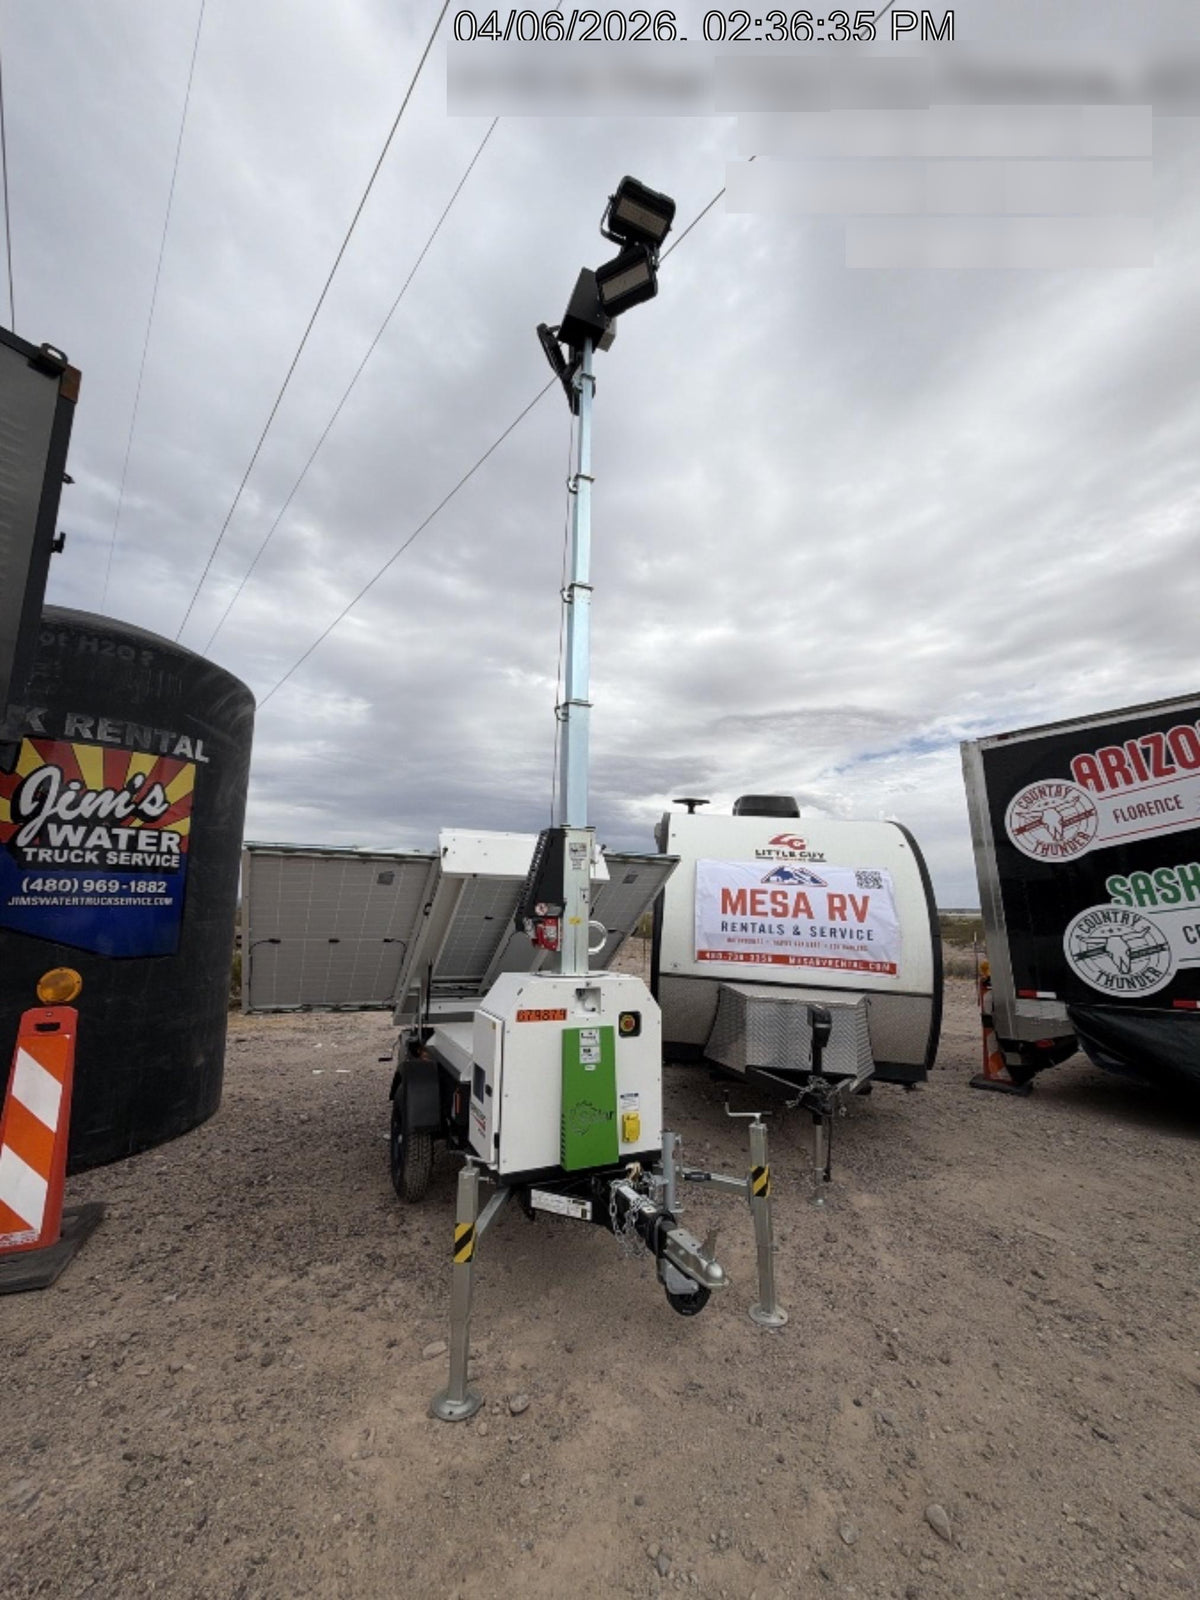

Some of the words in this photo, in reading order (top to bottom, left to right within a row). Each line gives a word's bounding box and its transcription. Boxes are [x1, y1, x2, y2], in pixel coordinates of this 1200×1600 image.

[64, 711, 211, 764] RENTAL
[1070, 720, 1200, 793] ARIZO
[17, 765, 168, 848] Jim's
[1016, 784, 1074, 810] COUNTRY
[1112, 793, 1185, 825] FLORENCE
[47, 822, 182, 855] WATER
[1032, 831, 1092, 856] THUNDER
[22, 847, 101, 866] TRUCK
[106, 850, 181, 869] SERVICE
[755, 849, 796, 857] LITTLE
[22, 877, 79, 894] (480)
[82, 879, 168, 894] 969-1882
[720, 888, 815, 920] MESA
[826, 893, 871, 923] RV
[720, 920, 785, 935] RENTALS
[792, 926, 802, 937] &
[809, 926, 875, 942] SERVICE
[1077, 911, 1142, 934] COUNTRY
[1096, 966, 1162, 990] THUNDER
